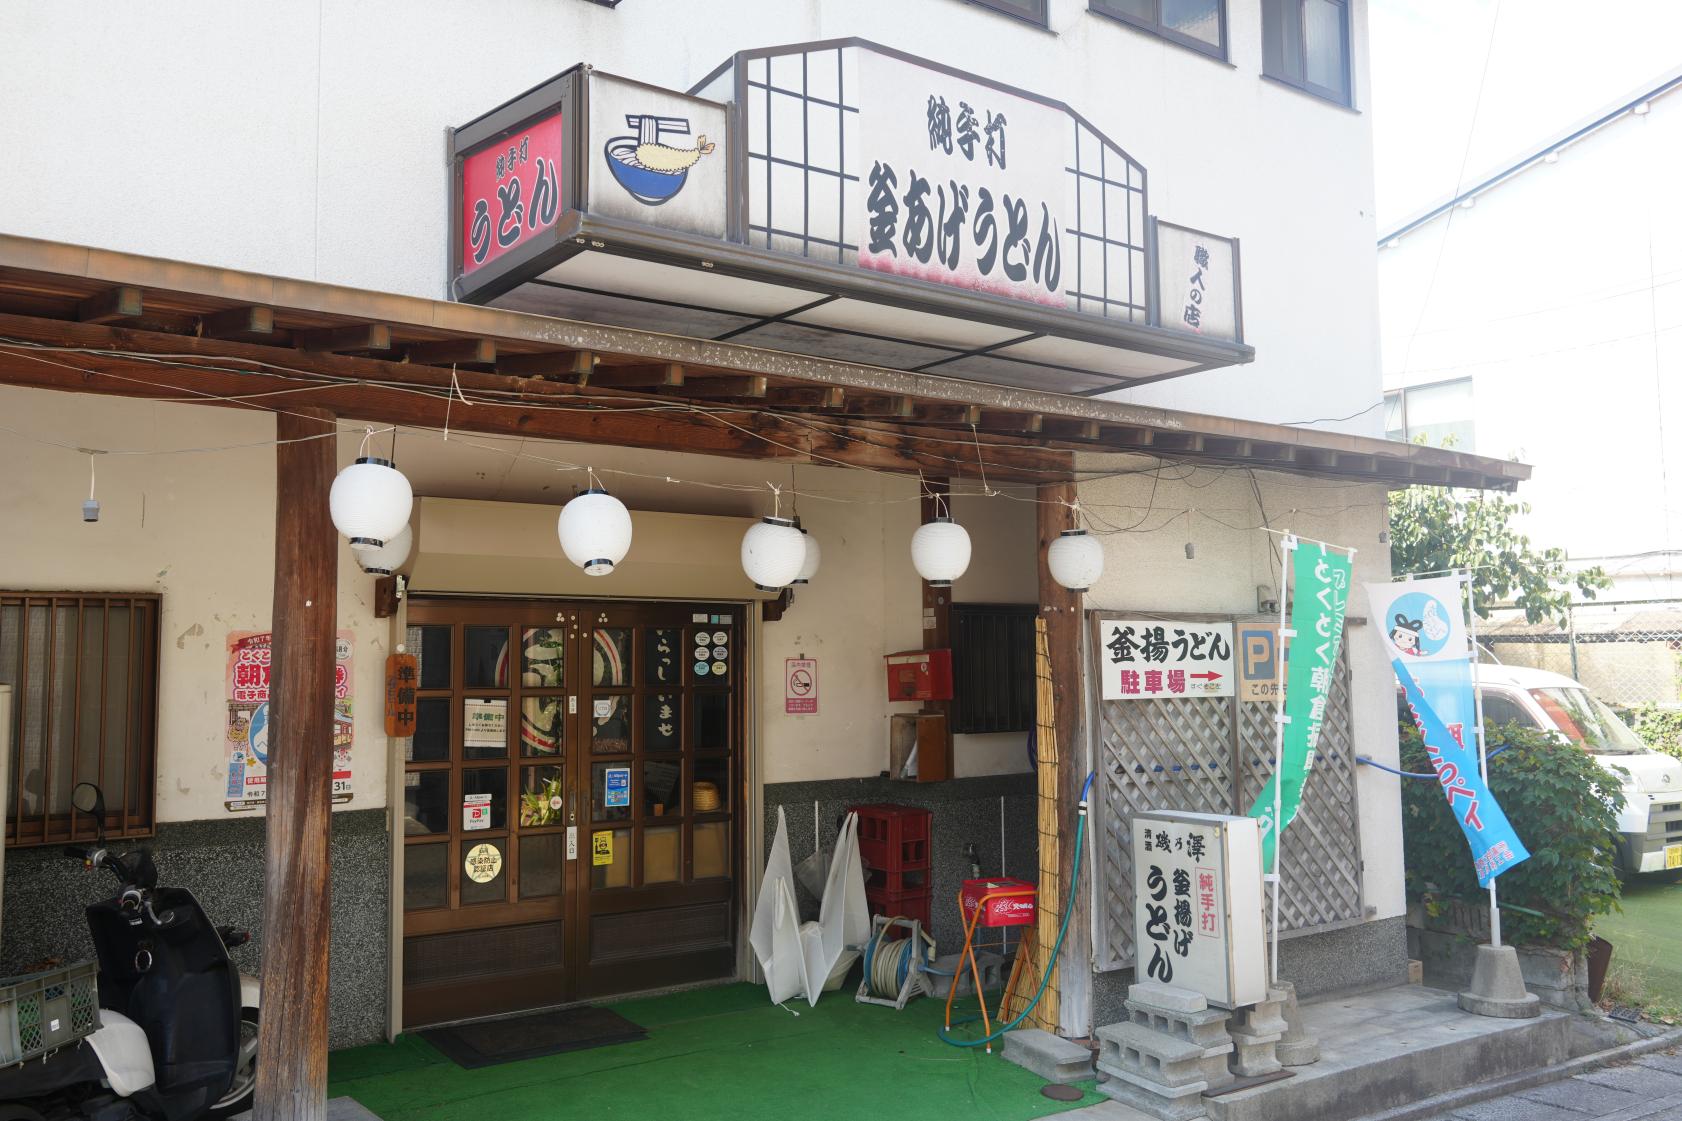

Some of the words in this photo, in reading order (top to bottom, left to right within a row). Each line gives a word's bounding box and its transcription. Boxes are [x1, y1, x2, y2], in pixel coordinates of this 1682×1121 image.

[495, 135, 530, 183] 純手打
[927, 94, 1008, 170] 純手打
[470, 156, 559, 265] うどん
[866, 159, 1061, 293] 釜あげうどん
[1183, 244, 1212, 329] 職人の店
[1106, 626, 1231, 664] 釜揚うどん
[1120, 669, 1186, 695] 駐車場
[1145, 864, 1174, 984] うどん
[1172, 867, 1194, 958] 釜揚げ
[1199, 872, 1216, 932] 純手打
